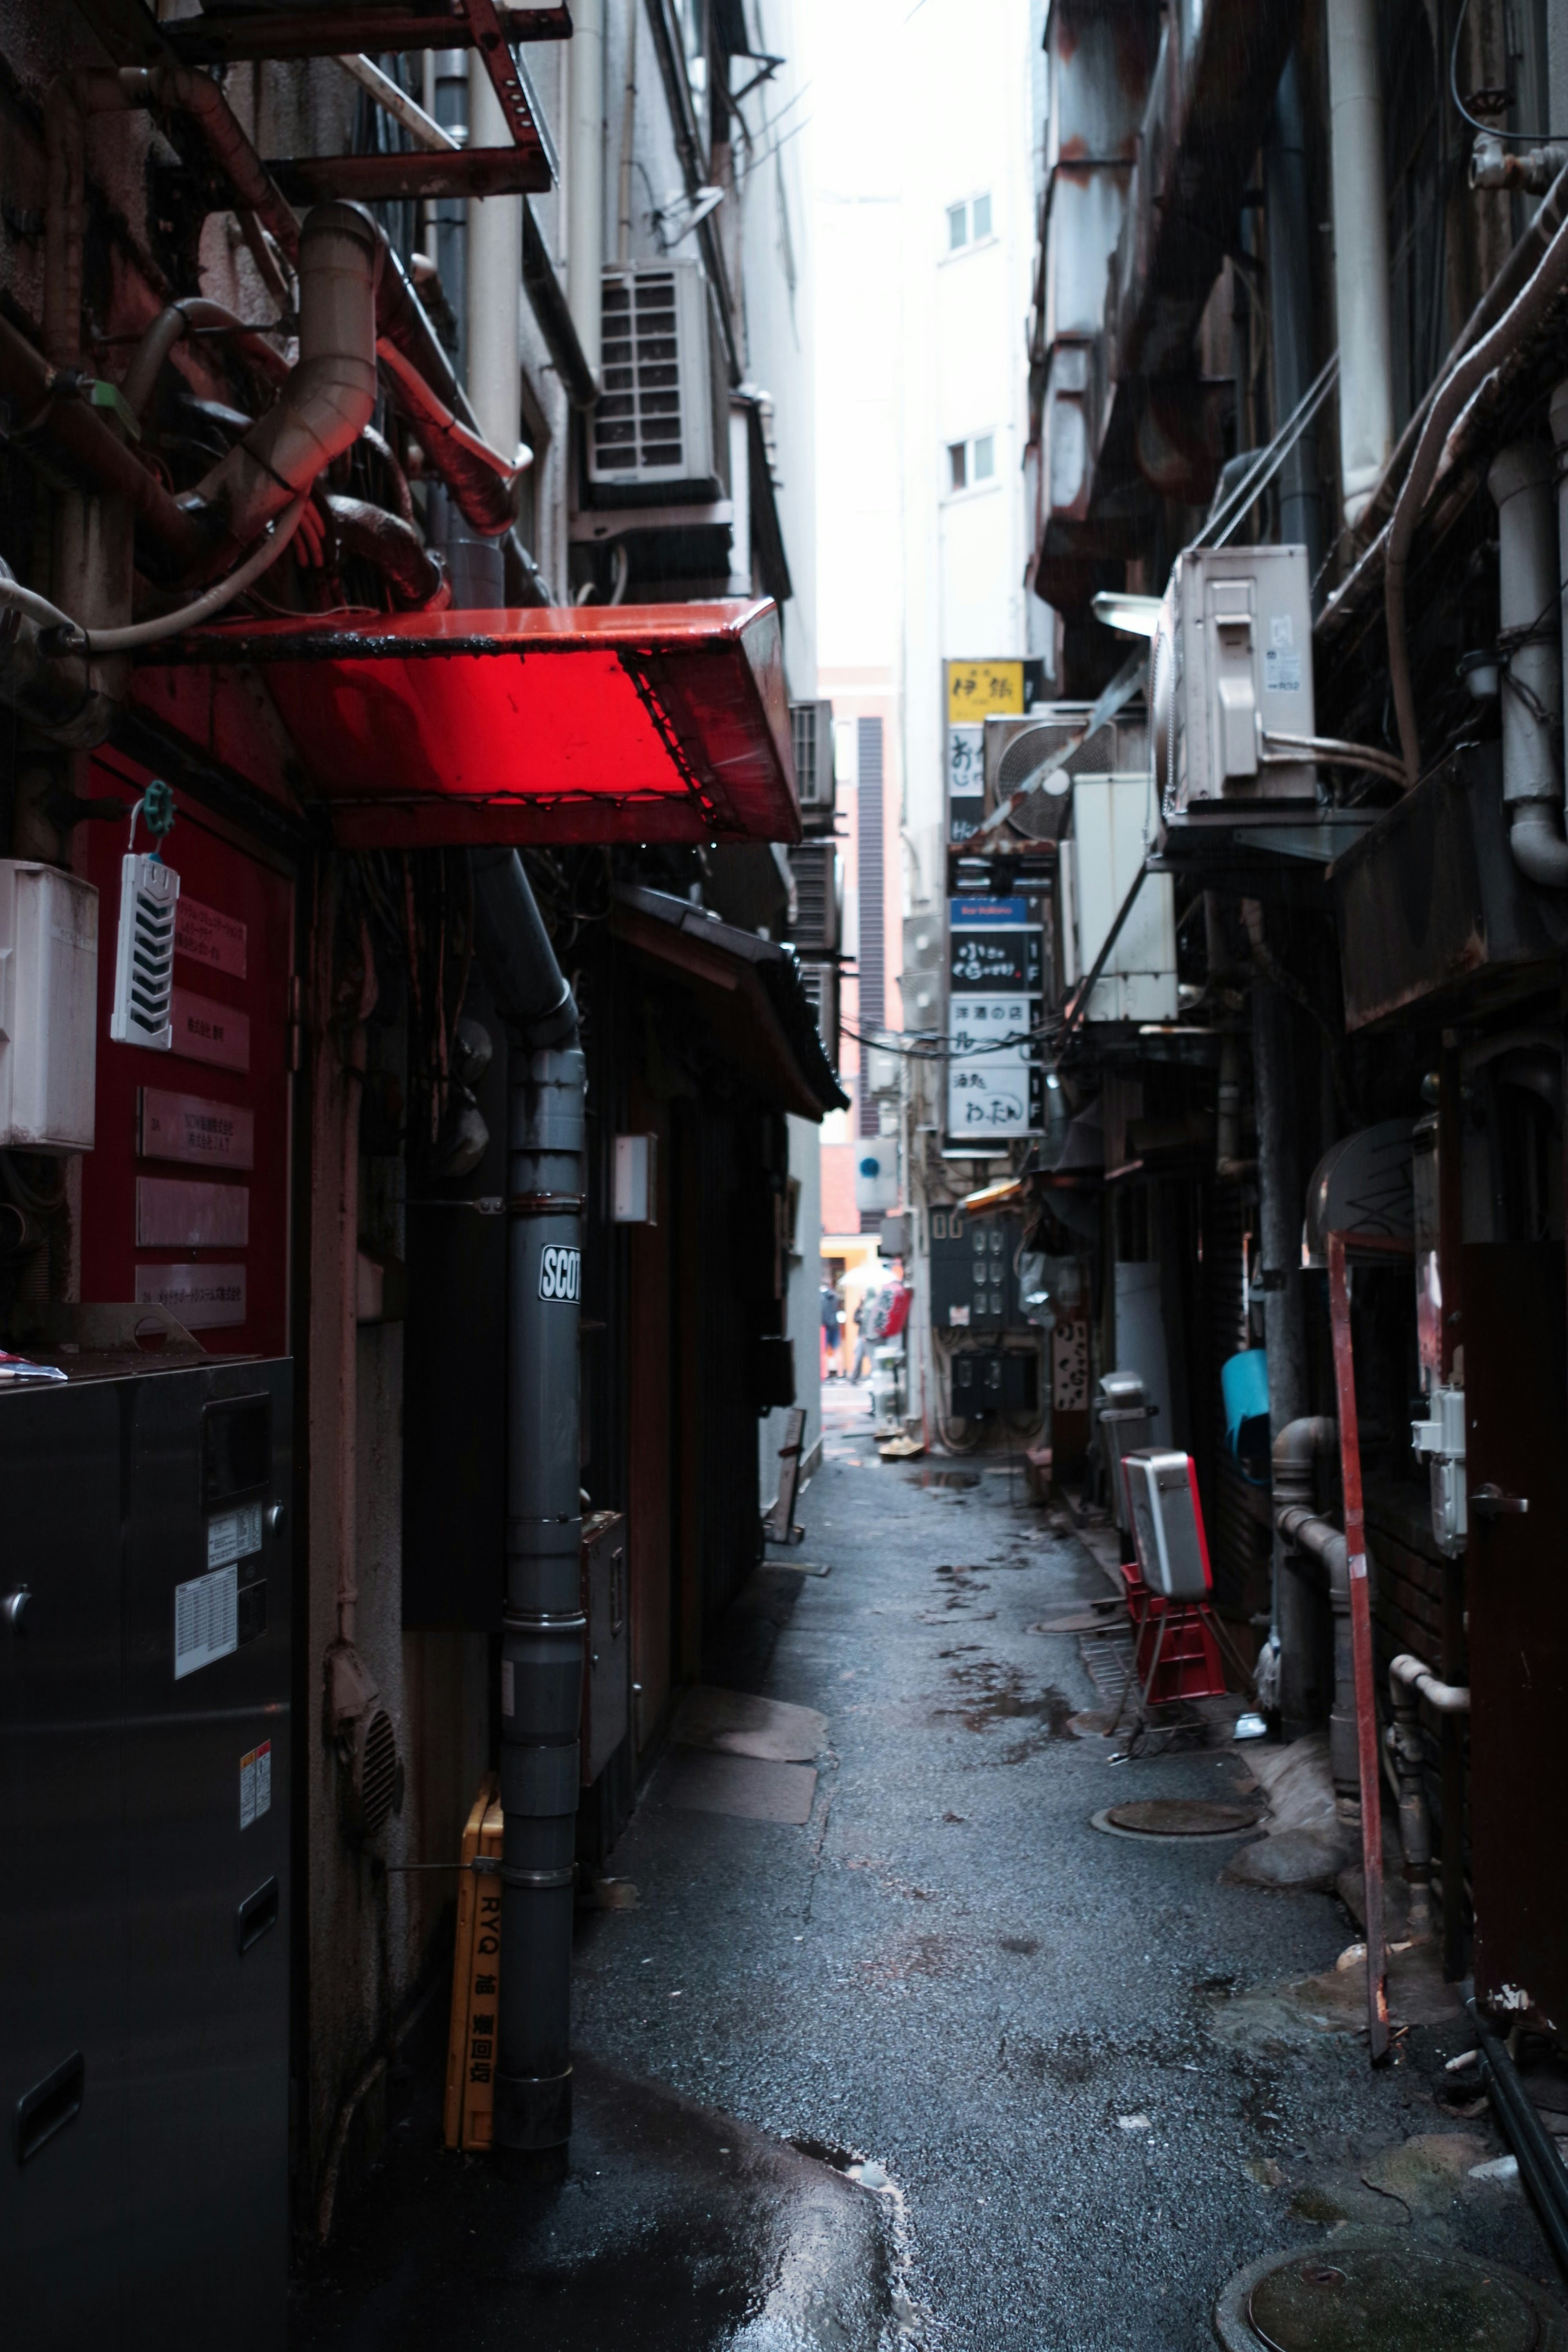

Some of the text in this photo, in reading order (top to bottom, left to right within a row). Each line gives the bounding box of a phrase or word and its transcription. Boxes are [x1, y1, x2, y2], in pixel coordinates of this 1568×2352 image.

[955, 1006, 1022, 1021] 洋酒の店
[469, 1897, 501, 2084] RYQ 旭 要回収
